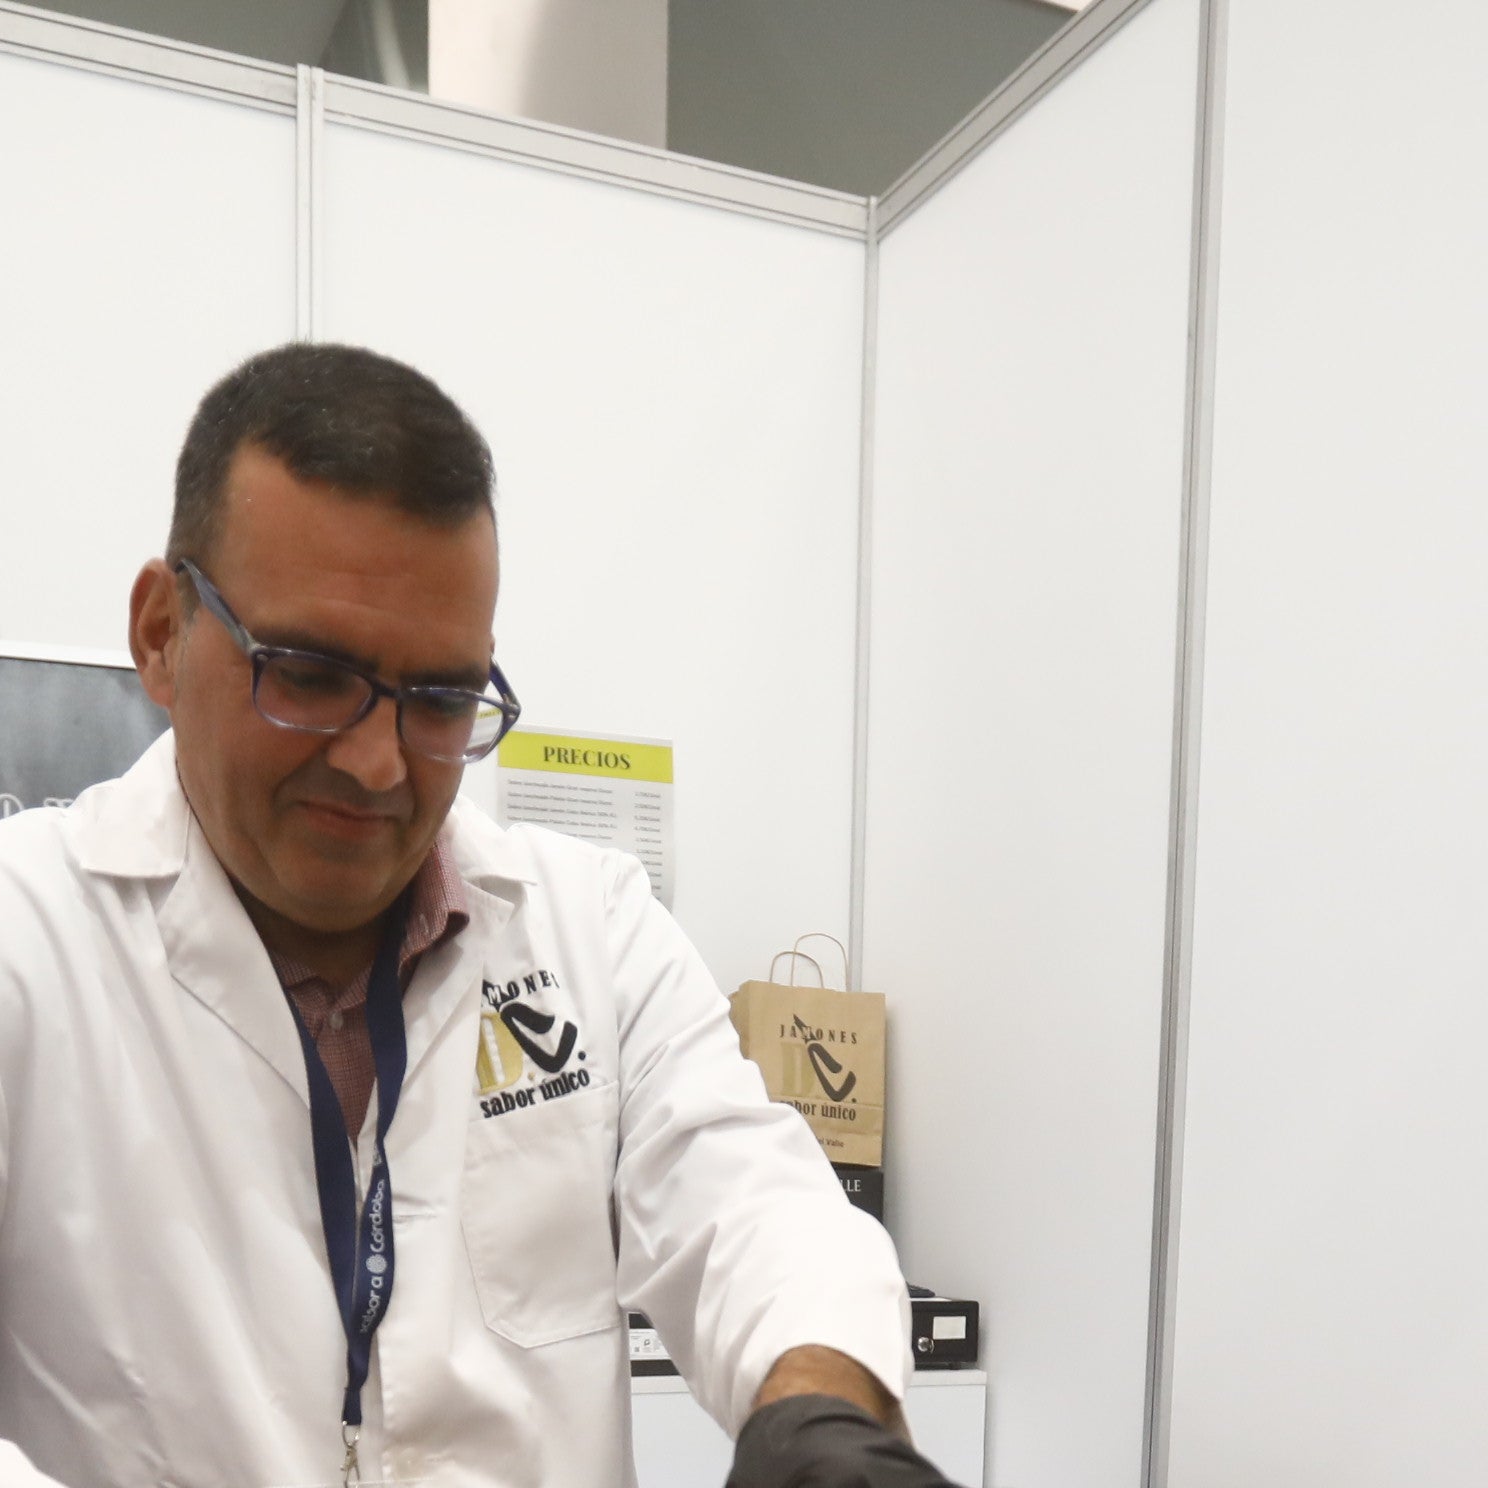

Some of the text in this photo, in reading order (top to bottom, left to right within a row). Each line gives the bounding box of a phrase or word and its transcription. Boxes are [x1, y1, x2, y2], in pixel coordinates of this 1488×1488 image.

[542, 745, 631, 771] PRECIOS
[486, 969, 561, 1006] MONE
[779, 1023, 858, 1045] JAMONES
[478, 1067, 590, 1119] sabor único
[821, 1102, 856, 1121] único
[371, 1275, 384, 1289] a
